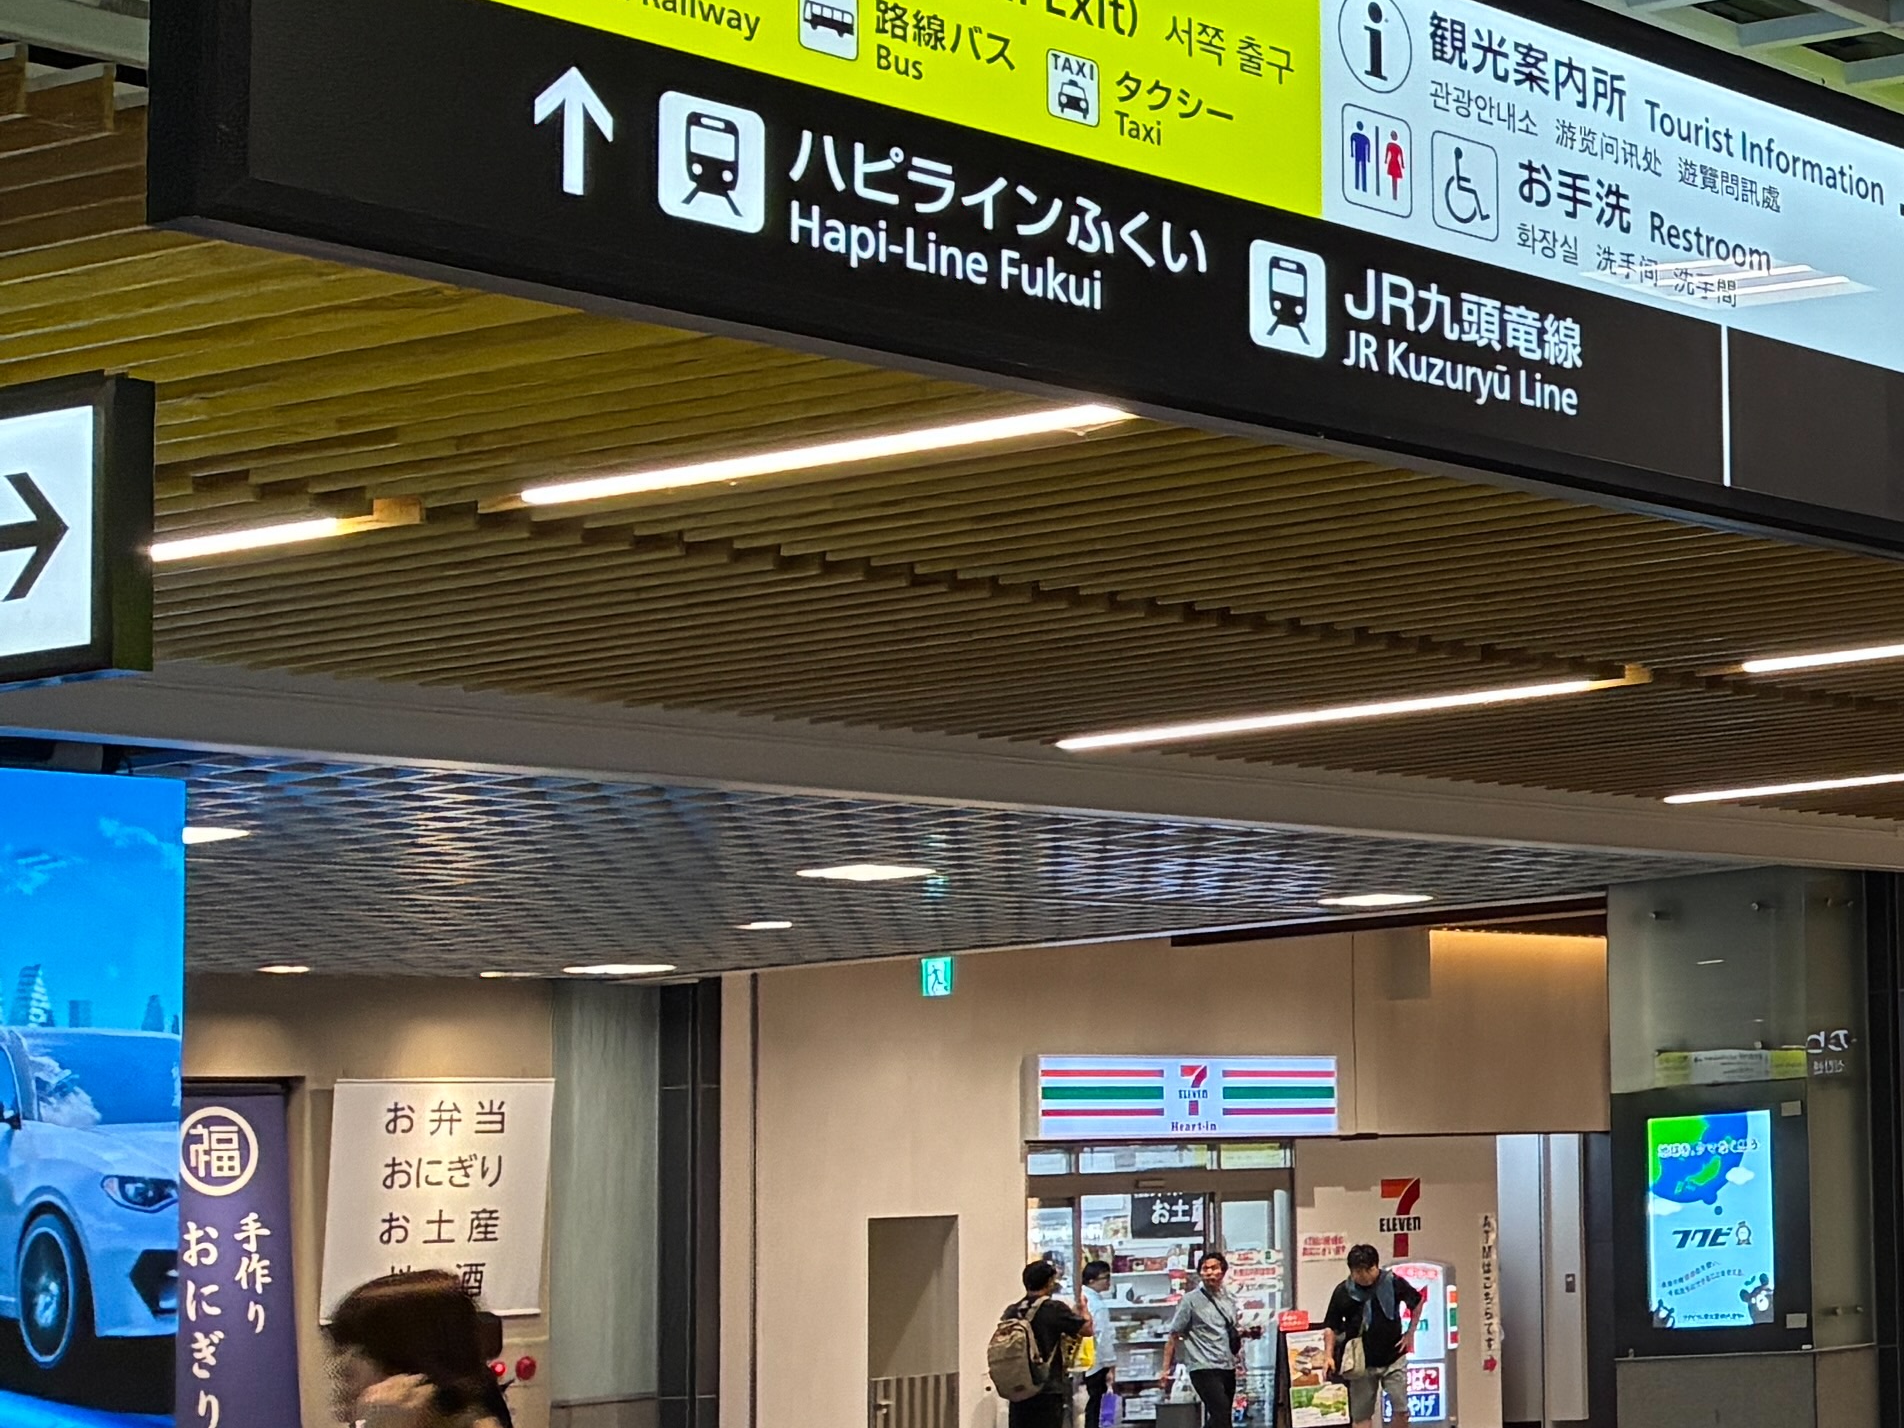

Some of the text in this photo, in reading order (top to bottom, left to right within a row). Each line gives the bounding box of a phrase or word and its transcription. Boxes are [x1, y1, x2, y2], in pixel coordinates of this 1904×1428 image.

[875, 0, 1015, 72] 路線バス
[876, 45, 924, 81] Bus
[1165, 16, 1296, 86] 서쪽 출구
[1052, 53, 1095, 81] TAXI
[1116, 71, 1235, 122] タクシー
[1429, 10, 1626, 123] 観光案内所
[1115, 110, 1162, 147] Taxi
[1429, 80, 1539, 137] 관광안내소
[1555, 118, 1662, 178] 游览问讯处
[1645, 98, 1885, 207] Tourist Information
[789, 129, 1208, 273] ハピラインふくい
[1517, 158, 1632, 234] お手洗
[790, 200, 1101, 310] Hapi-Line Fukui
[1517, 221, 1580, 266] 화장실
[1596, 243, 1659, 288] 洗手间
[1649, 210, 1771, 276] Restroom
[1344, 268, 1583, 369] JR九頭竜線
[1343, 330, 1578, 416] JR Kuzuryū Line
[385, 1099, 505, 1136] お弁当
[382, 1153, 502, 1190] おにぎり
[379, 1208, 500, 1245] お土産
[1672, 1228, 1733, 1249] フクビ
[234, 1212, 273, 1334] 手作り
